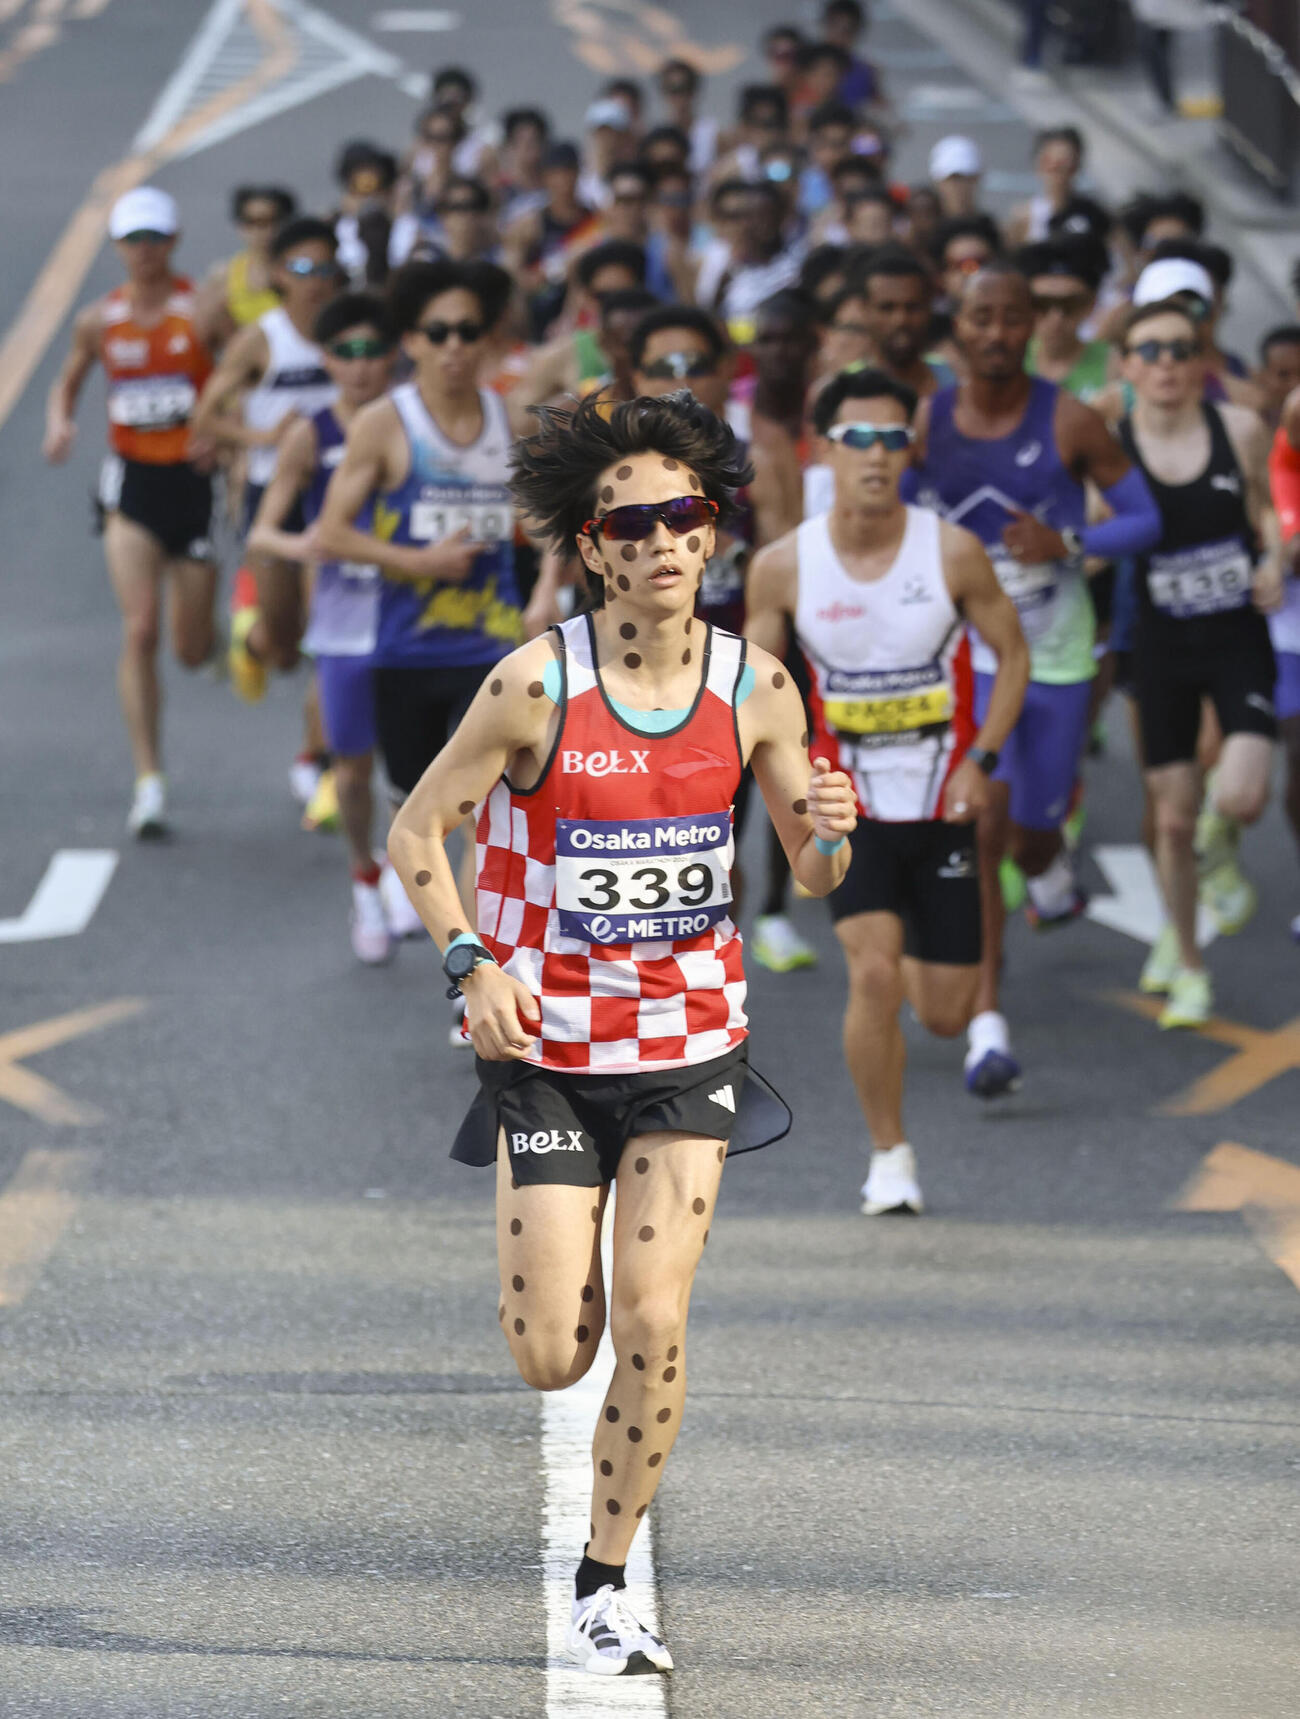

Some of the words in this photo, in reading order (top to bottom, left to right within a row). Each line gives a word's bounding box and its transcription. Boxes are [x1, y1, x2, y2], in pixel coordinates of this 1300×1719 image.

[570, 829, 651, 850] Osaka
[655, 825, 721, 848] Metro
[578, 863, 713, 911] 339
